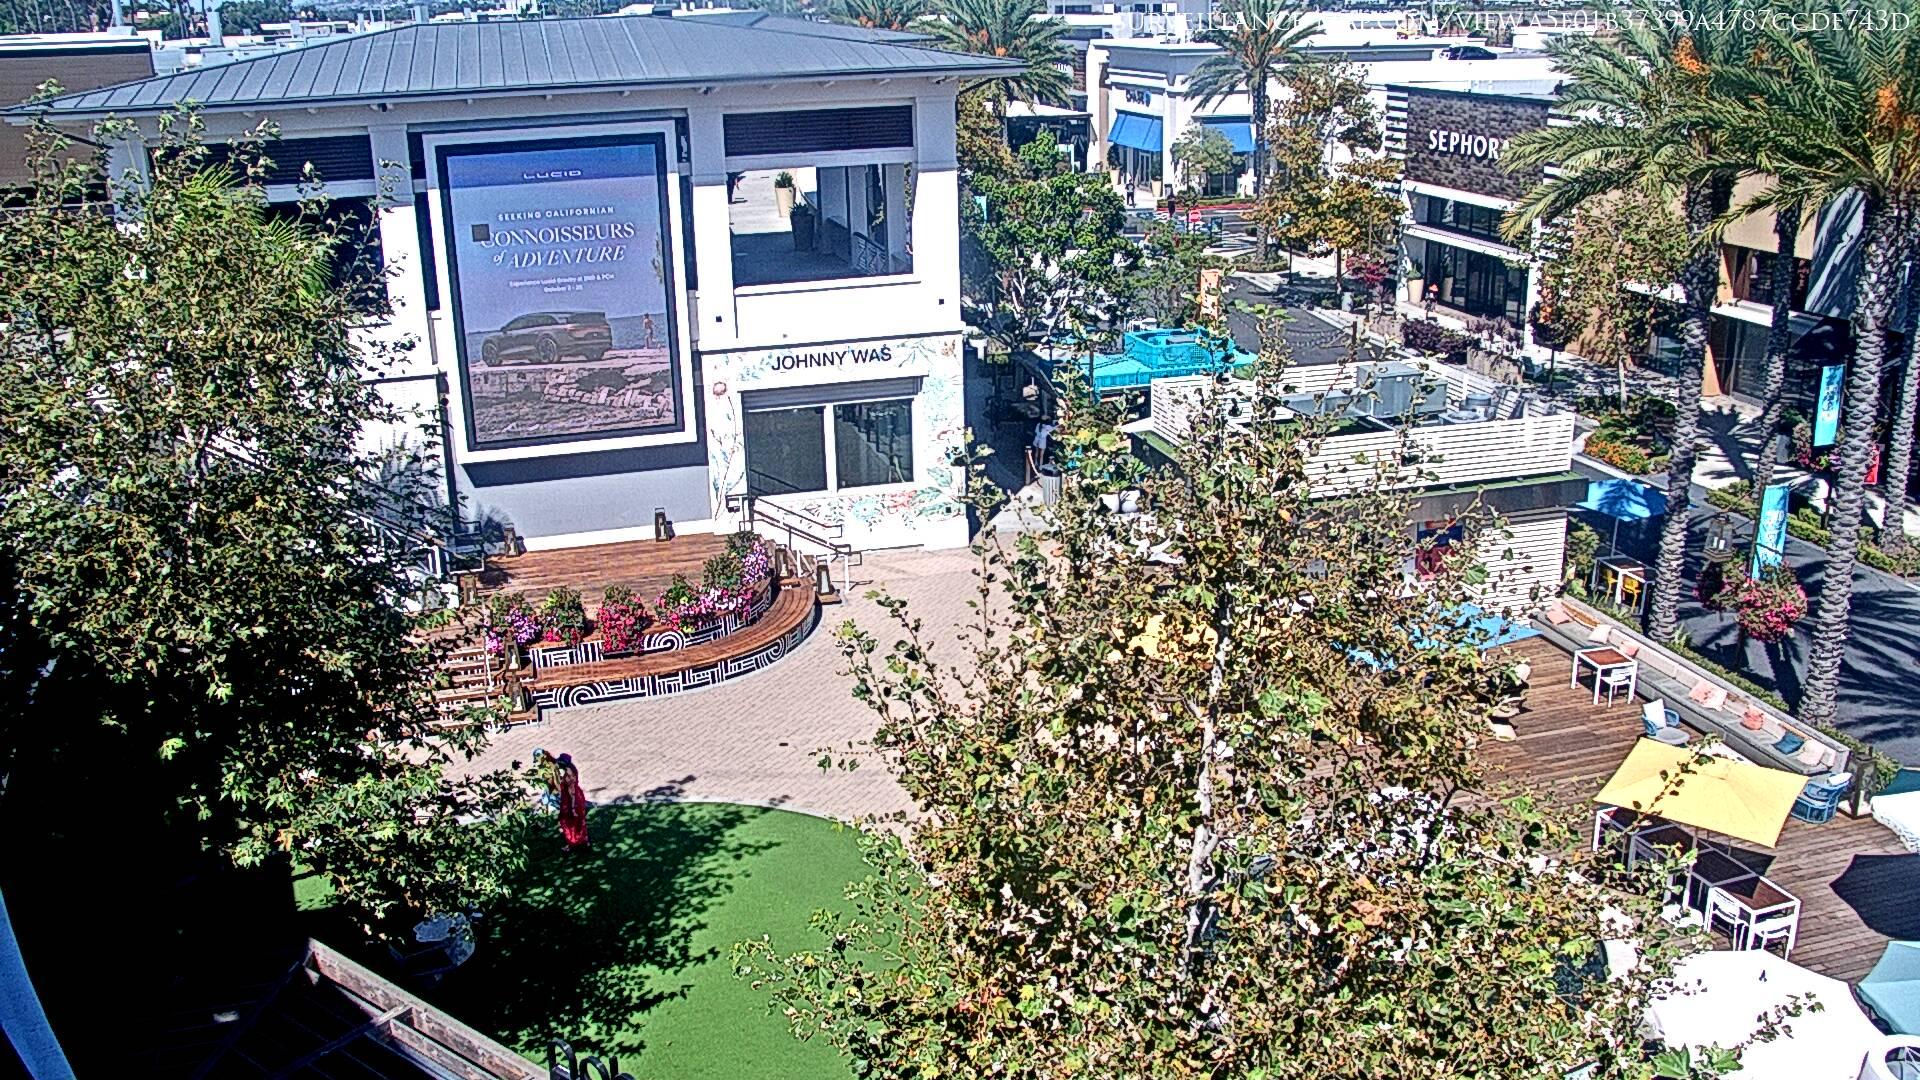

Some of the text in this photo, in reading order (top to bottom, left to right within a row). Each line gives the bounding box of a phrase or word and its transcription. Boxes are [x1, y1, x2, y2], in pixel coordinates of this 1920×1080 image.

[523, 170, 582, 179] LUCID
[498, 206, 614, 222] SEEKING CALIFORNIAN
[493, 244, 627, 269] of ADVENTURE
[771, 346, 892, 371] JOHNNY WAS
